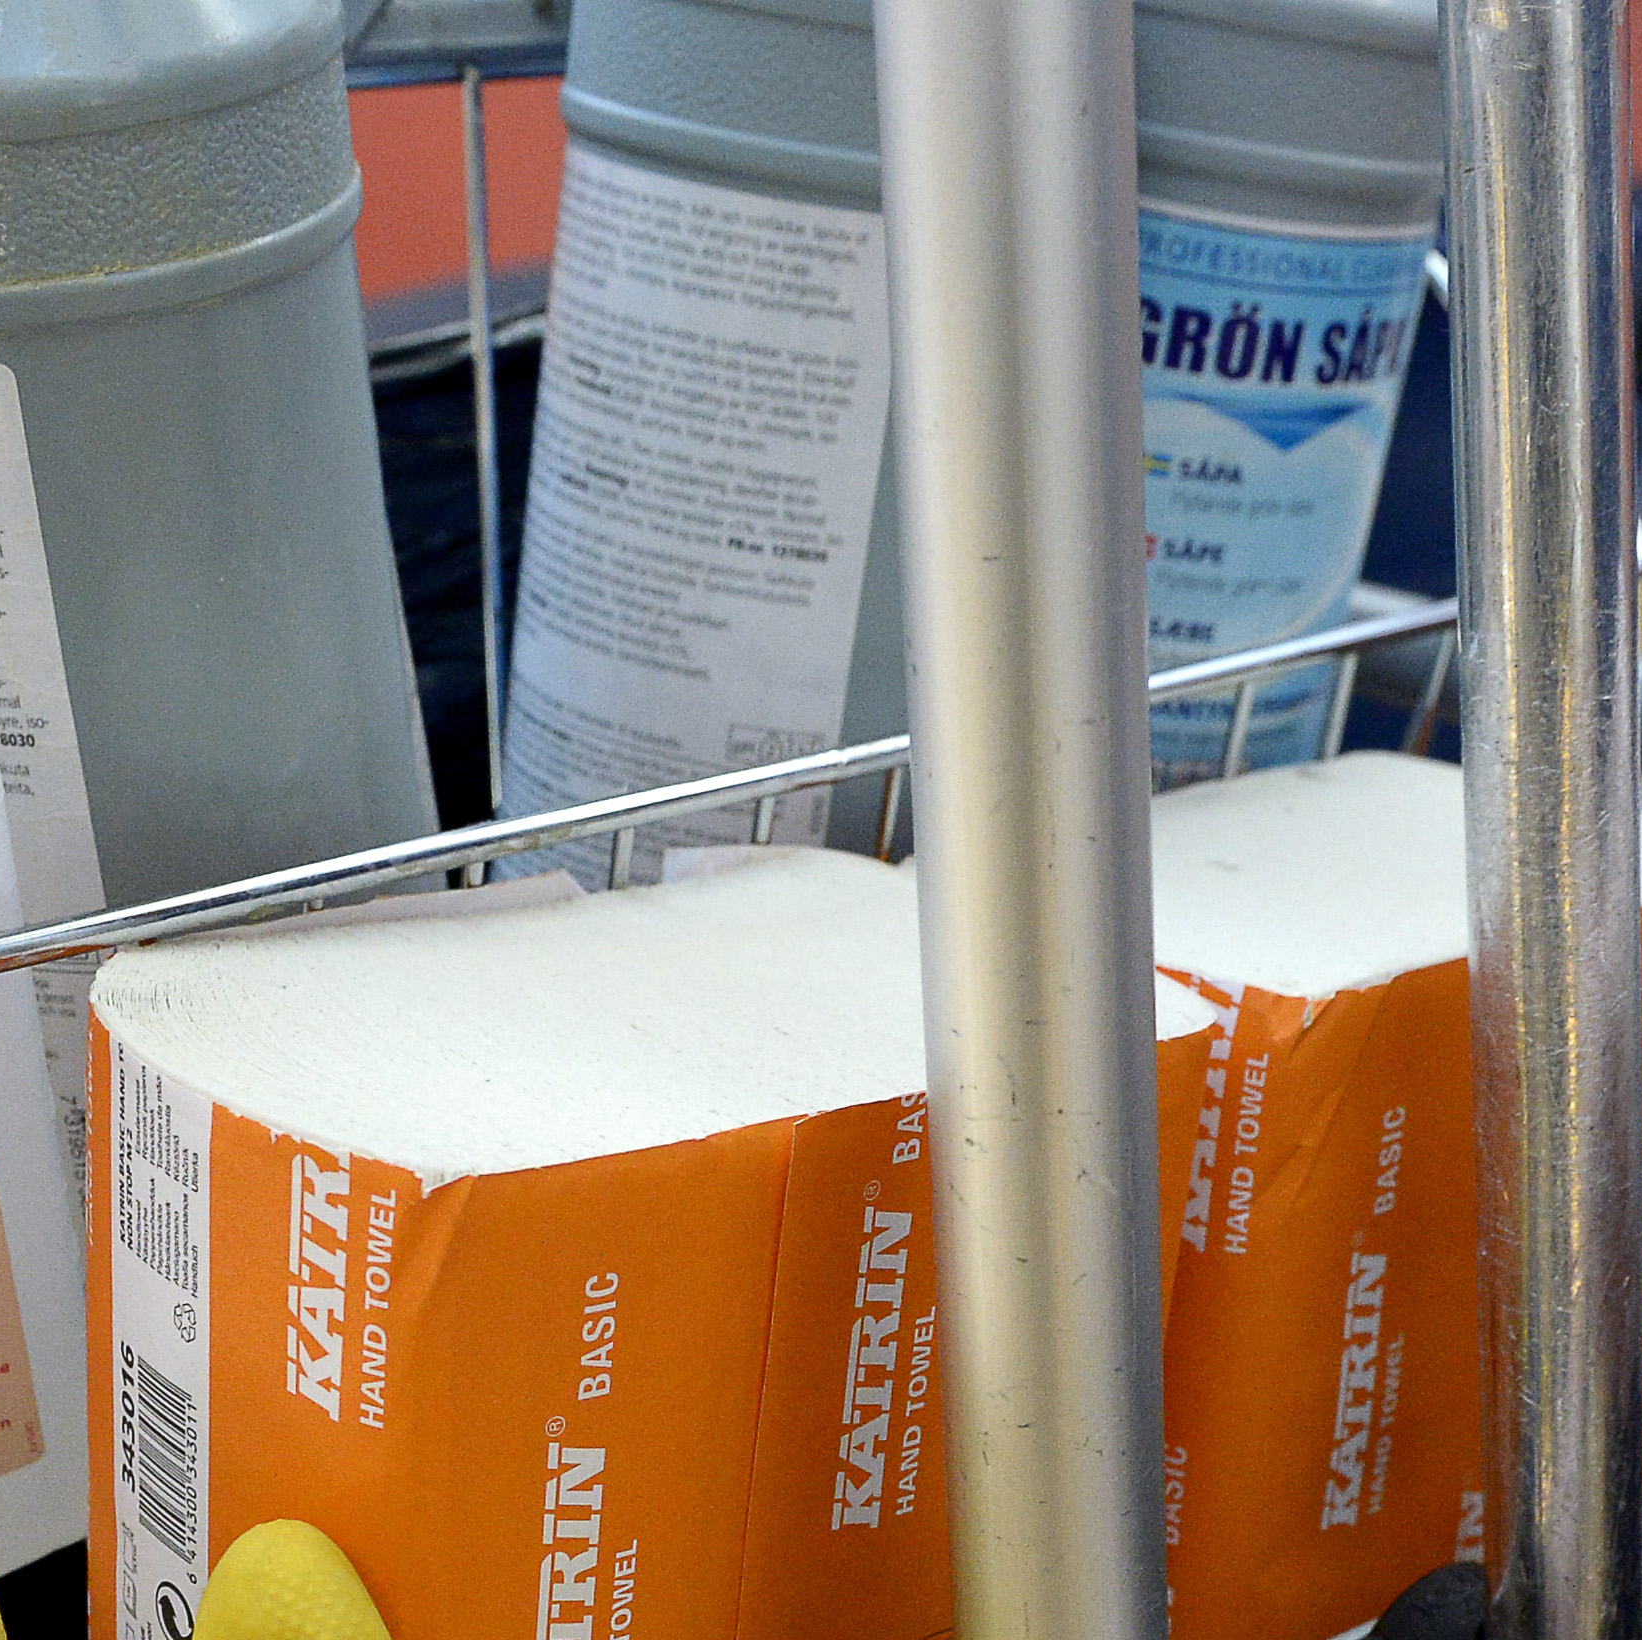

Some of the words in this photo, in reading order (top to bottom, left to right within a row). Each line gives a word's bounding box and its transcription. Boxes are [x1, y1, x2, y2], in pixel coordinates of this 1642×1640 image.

[1233, 1053, 1270, 1156] TOWEL
[364, 1189, 398, 1311] TOWEL
[1223, 1167, 1256, 1254] HAND
[189, 1244, 199, 1300] Handtuch
[1321, 1251, 1390, 1531] KATRIN
[1372, 1106, 1407, 1215] BASIC
[358, 1323, 388, 1429] HAND
[576, 1271, 619, 1401] BASIC
[830, 1205, 914, 1532] KATRIN
[904, 1306, 938, 1418] TOWEL
[1379, 1333, 1405, 1427] TOWEL
[120, 1339, 136, 1493] 343016
[186, 1403, 197, 1480] 343011
[894, 1425, 923, 1516] HAND
[1368, 1436, 1395, 1516] HAND
[186, 1485, 197, 1561] 414300
[186, 1571, 197, 1585] 6
